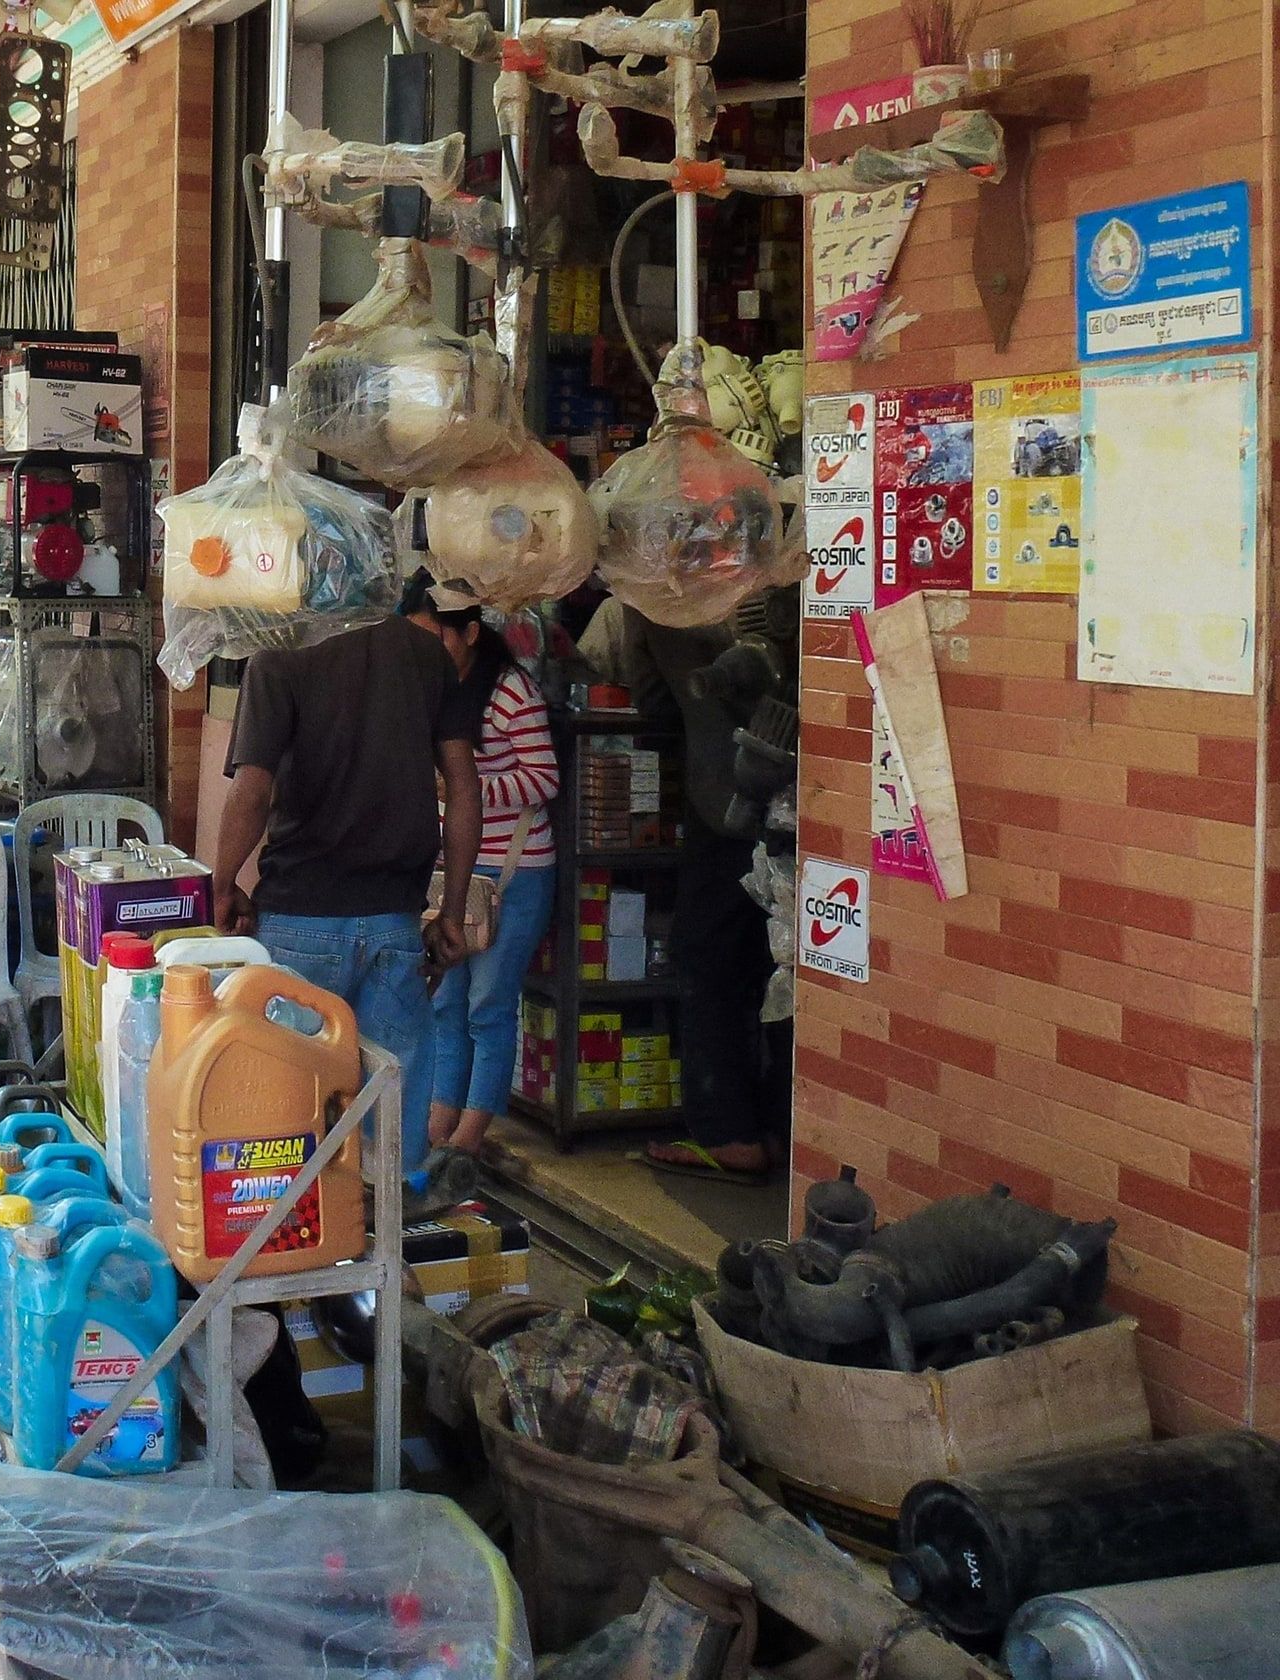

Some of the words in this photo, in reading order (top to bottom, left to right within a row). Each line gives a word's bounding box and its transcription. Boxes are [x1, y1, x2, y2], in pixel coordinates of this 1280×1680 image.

[45, 360, 90, 371] HARVEST
[101, 367, 127, 378] HV-62
[979, 387, 1004, 408] FBJ
[879, 399, 901, 420] FBJ
[810, 432, 868, 453] COSMIC
[810, 491, 838, 503] FROM
[809, 547, 866, 566] COSMIC
[808, 604, 836, 616] FROM
[805, 897, 862, 928] COSMIC
[805, 952, 833, 970] FROM
[251, 1137, 306, 1159] BUSAN
[280, 1154, 304, 1166] KING
[231, 1174, 293, 1203] 20W50
[227, 1204, 264, 1215] PREMIUM
